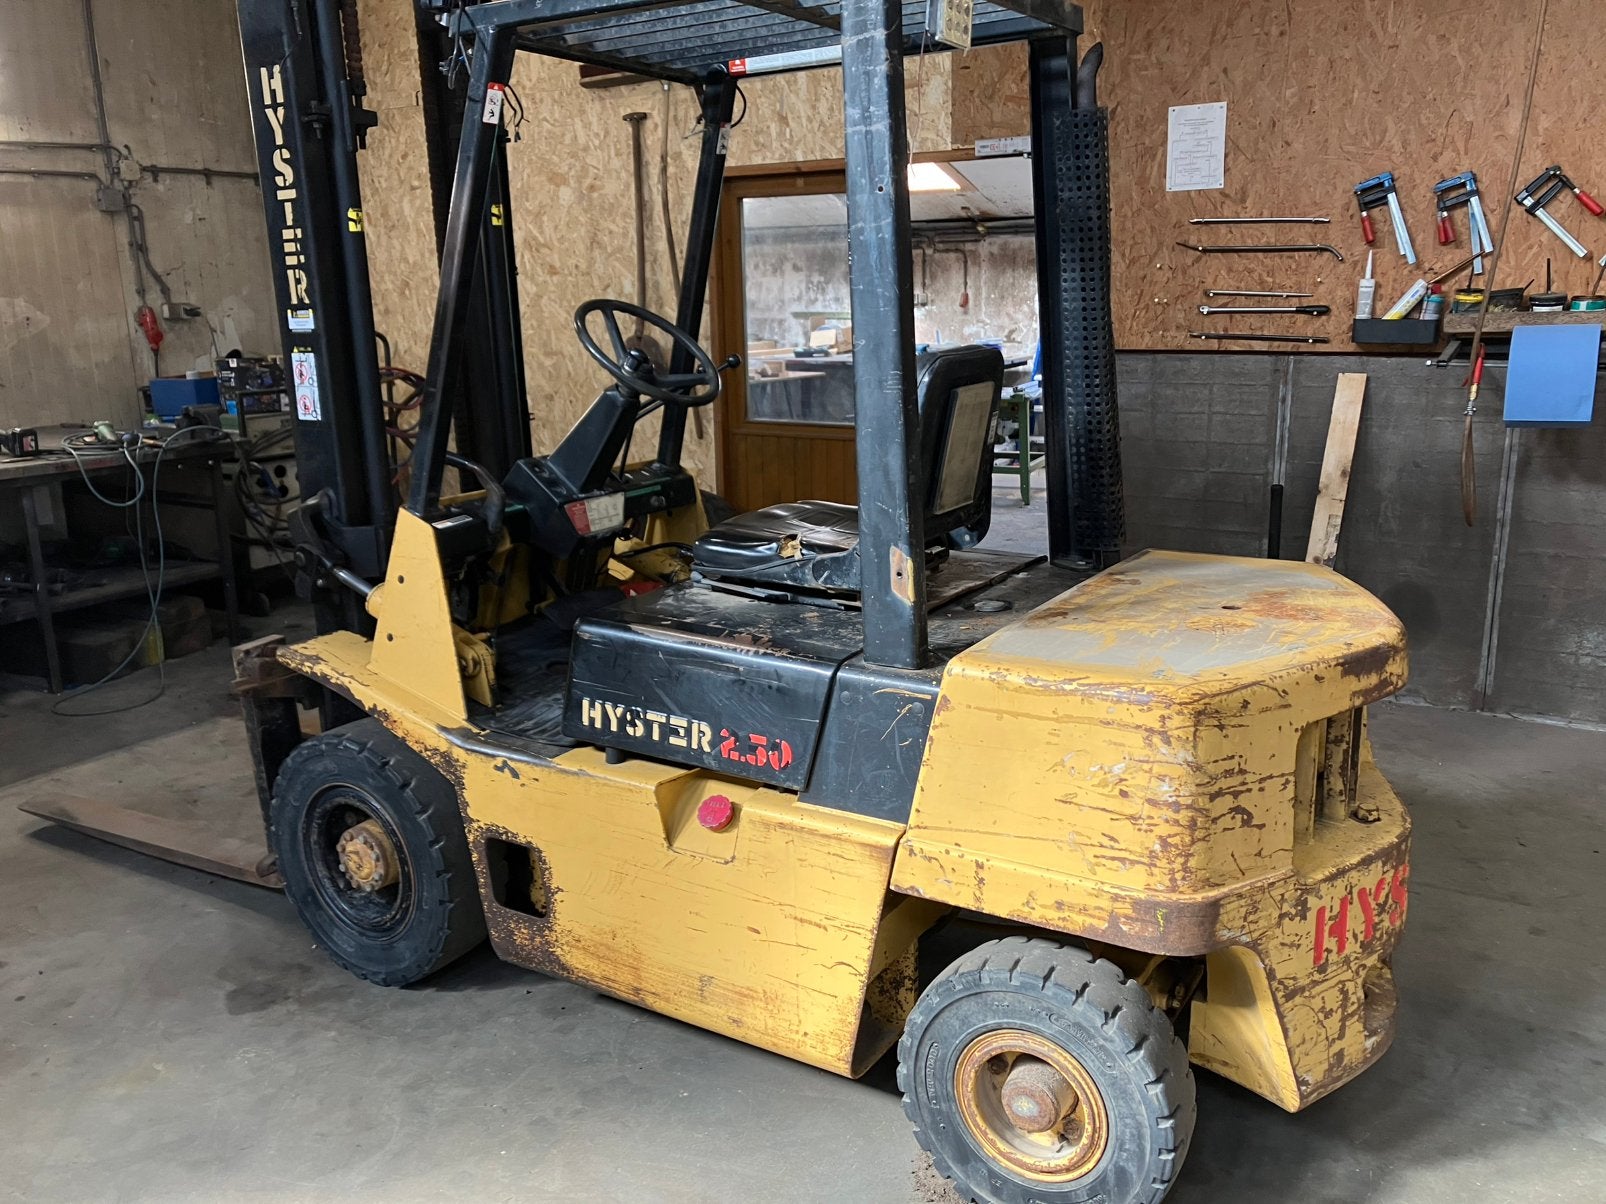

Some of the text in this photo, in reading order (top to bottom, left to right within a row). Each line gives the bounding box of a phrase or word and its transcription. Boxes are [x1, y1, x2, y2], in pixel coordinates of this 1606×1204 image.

[260, 65, 310, 304] HYSTER
[582, 697, 793, 771] HYSTER 2.50
